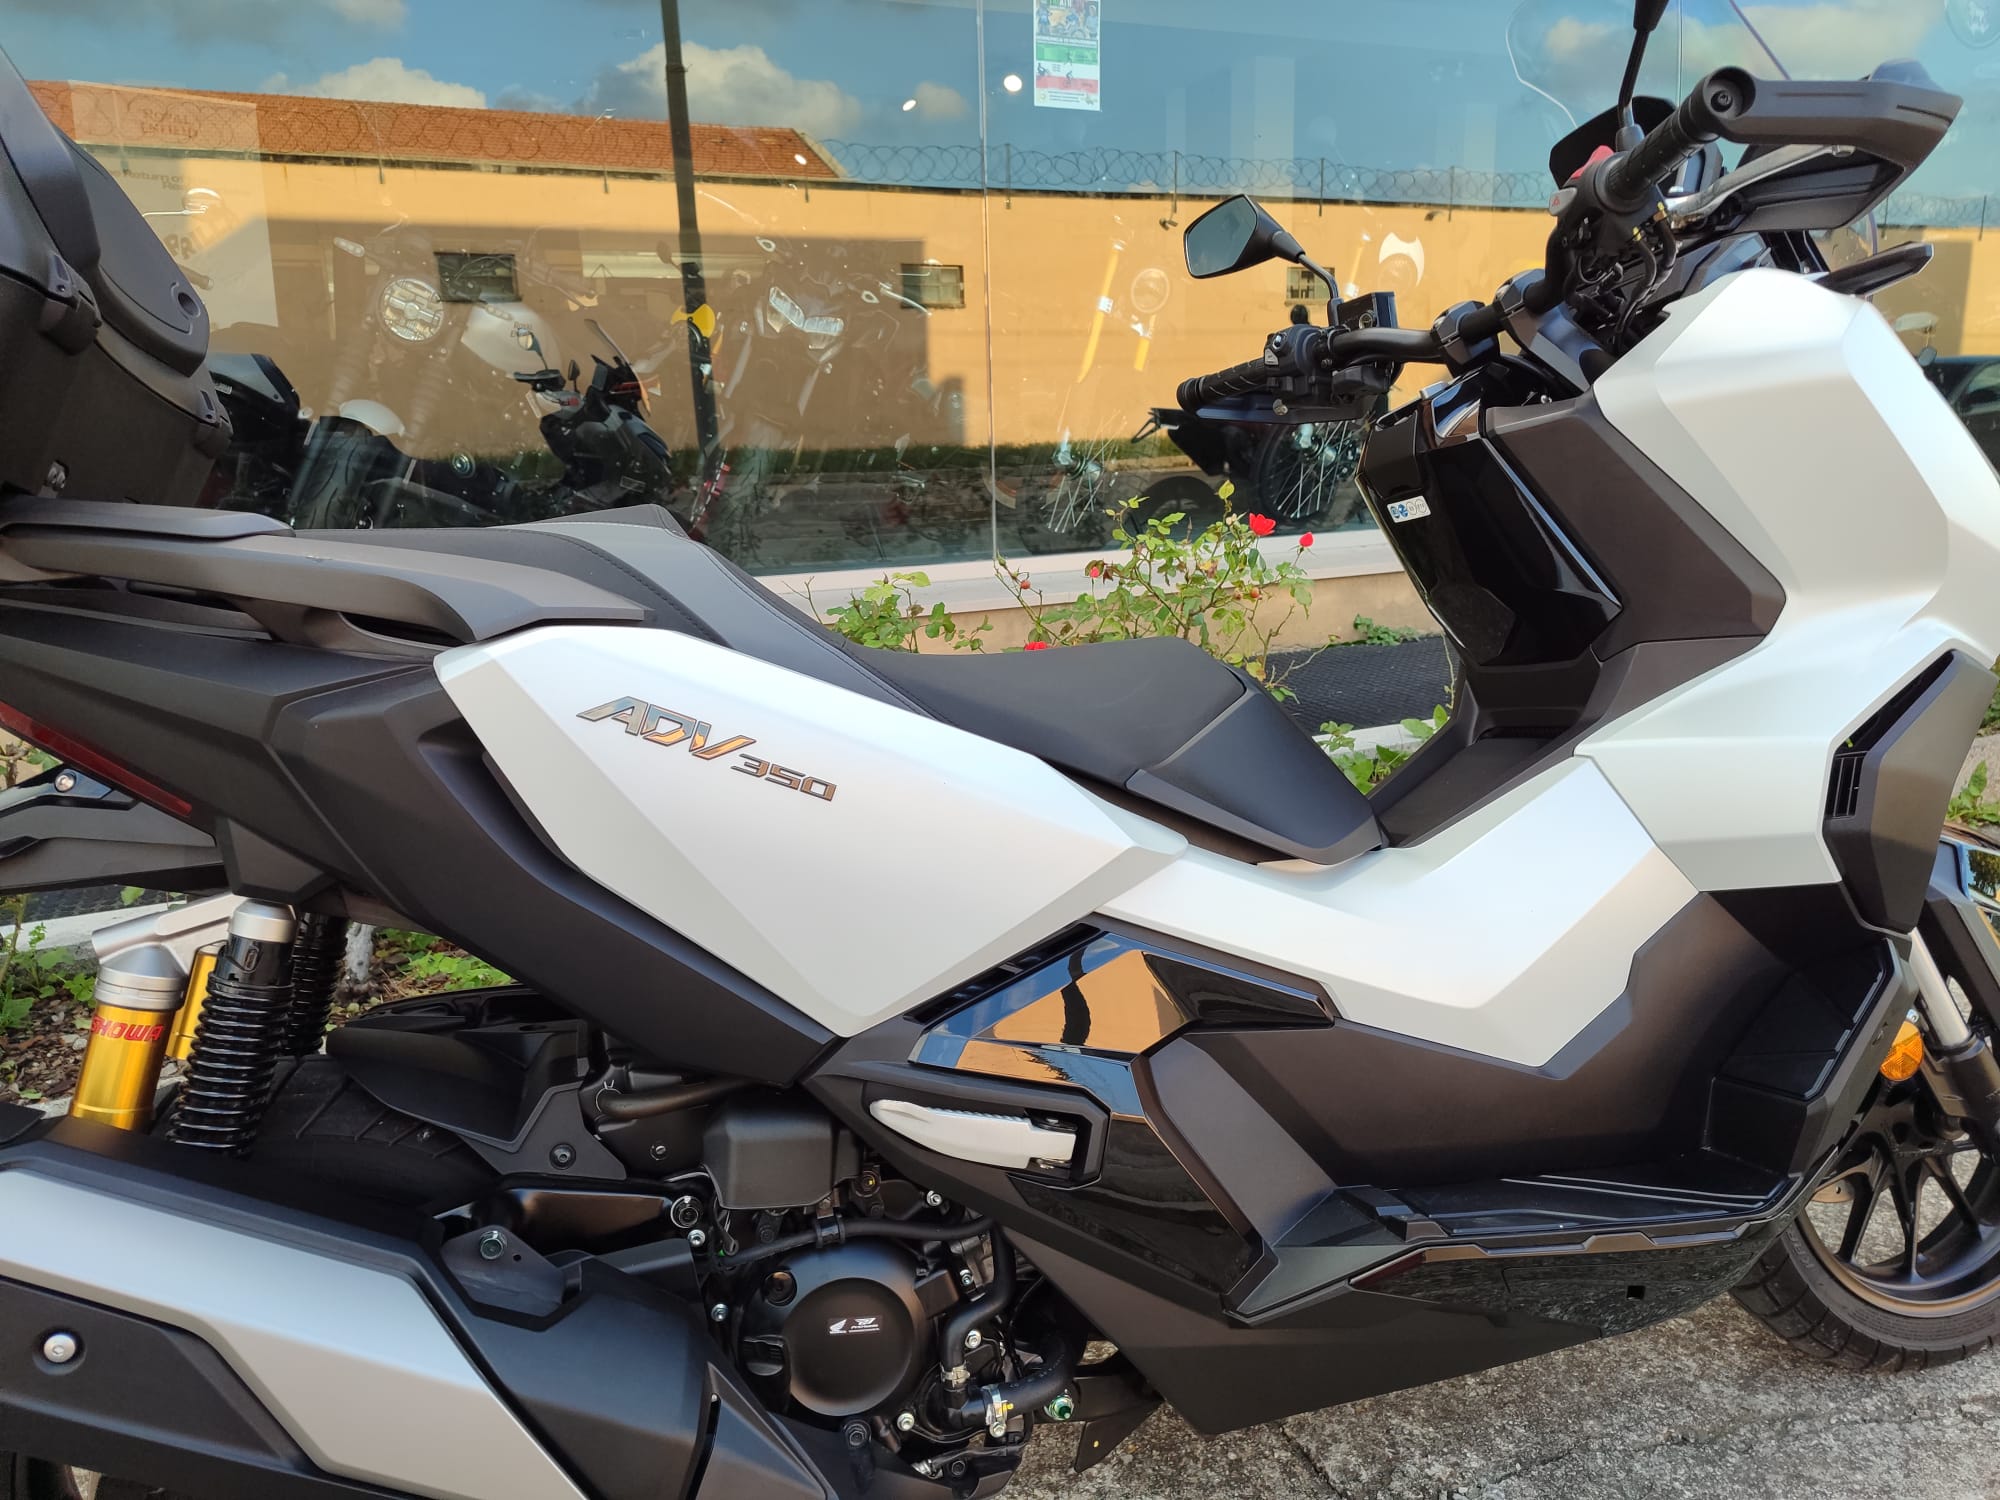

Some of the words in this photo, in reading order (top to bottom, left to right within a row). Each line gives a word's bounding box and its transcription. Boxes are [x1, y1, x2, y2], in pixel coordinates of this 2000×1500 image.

[576, 696, 757, 760] ADV
[730, 753, 837, 801] 350
[90, 1015, 165, 1042] SHOWA
